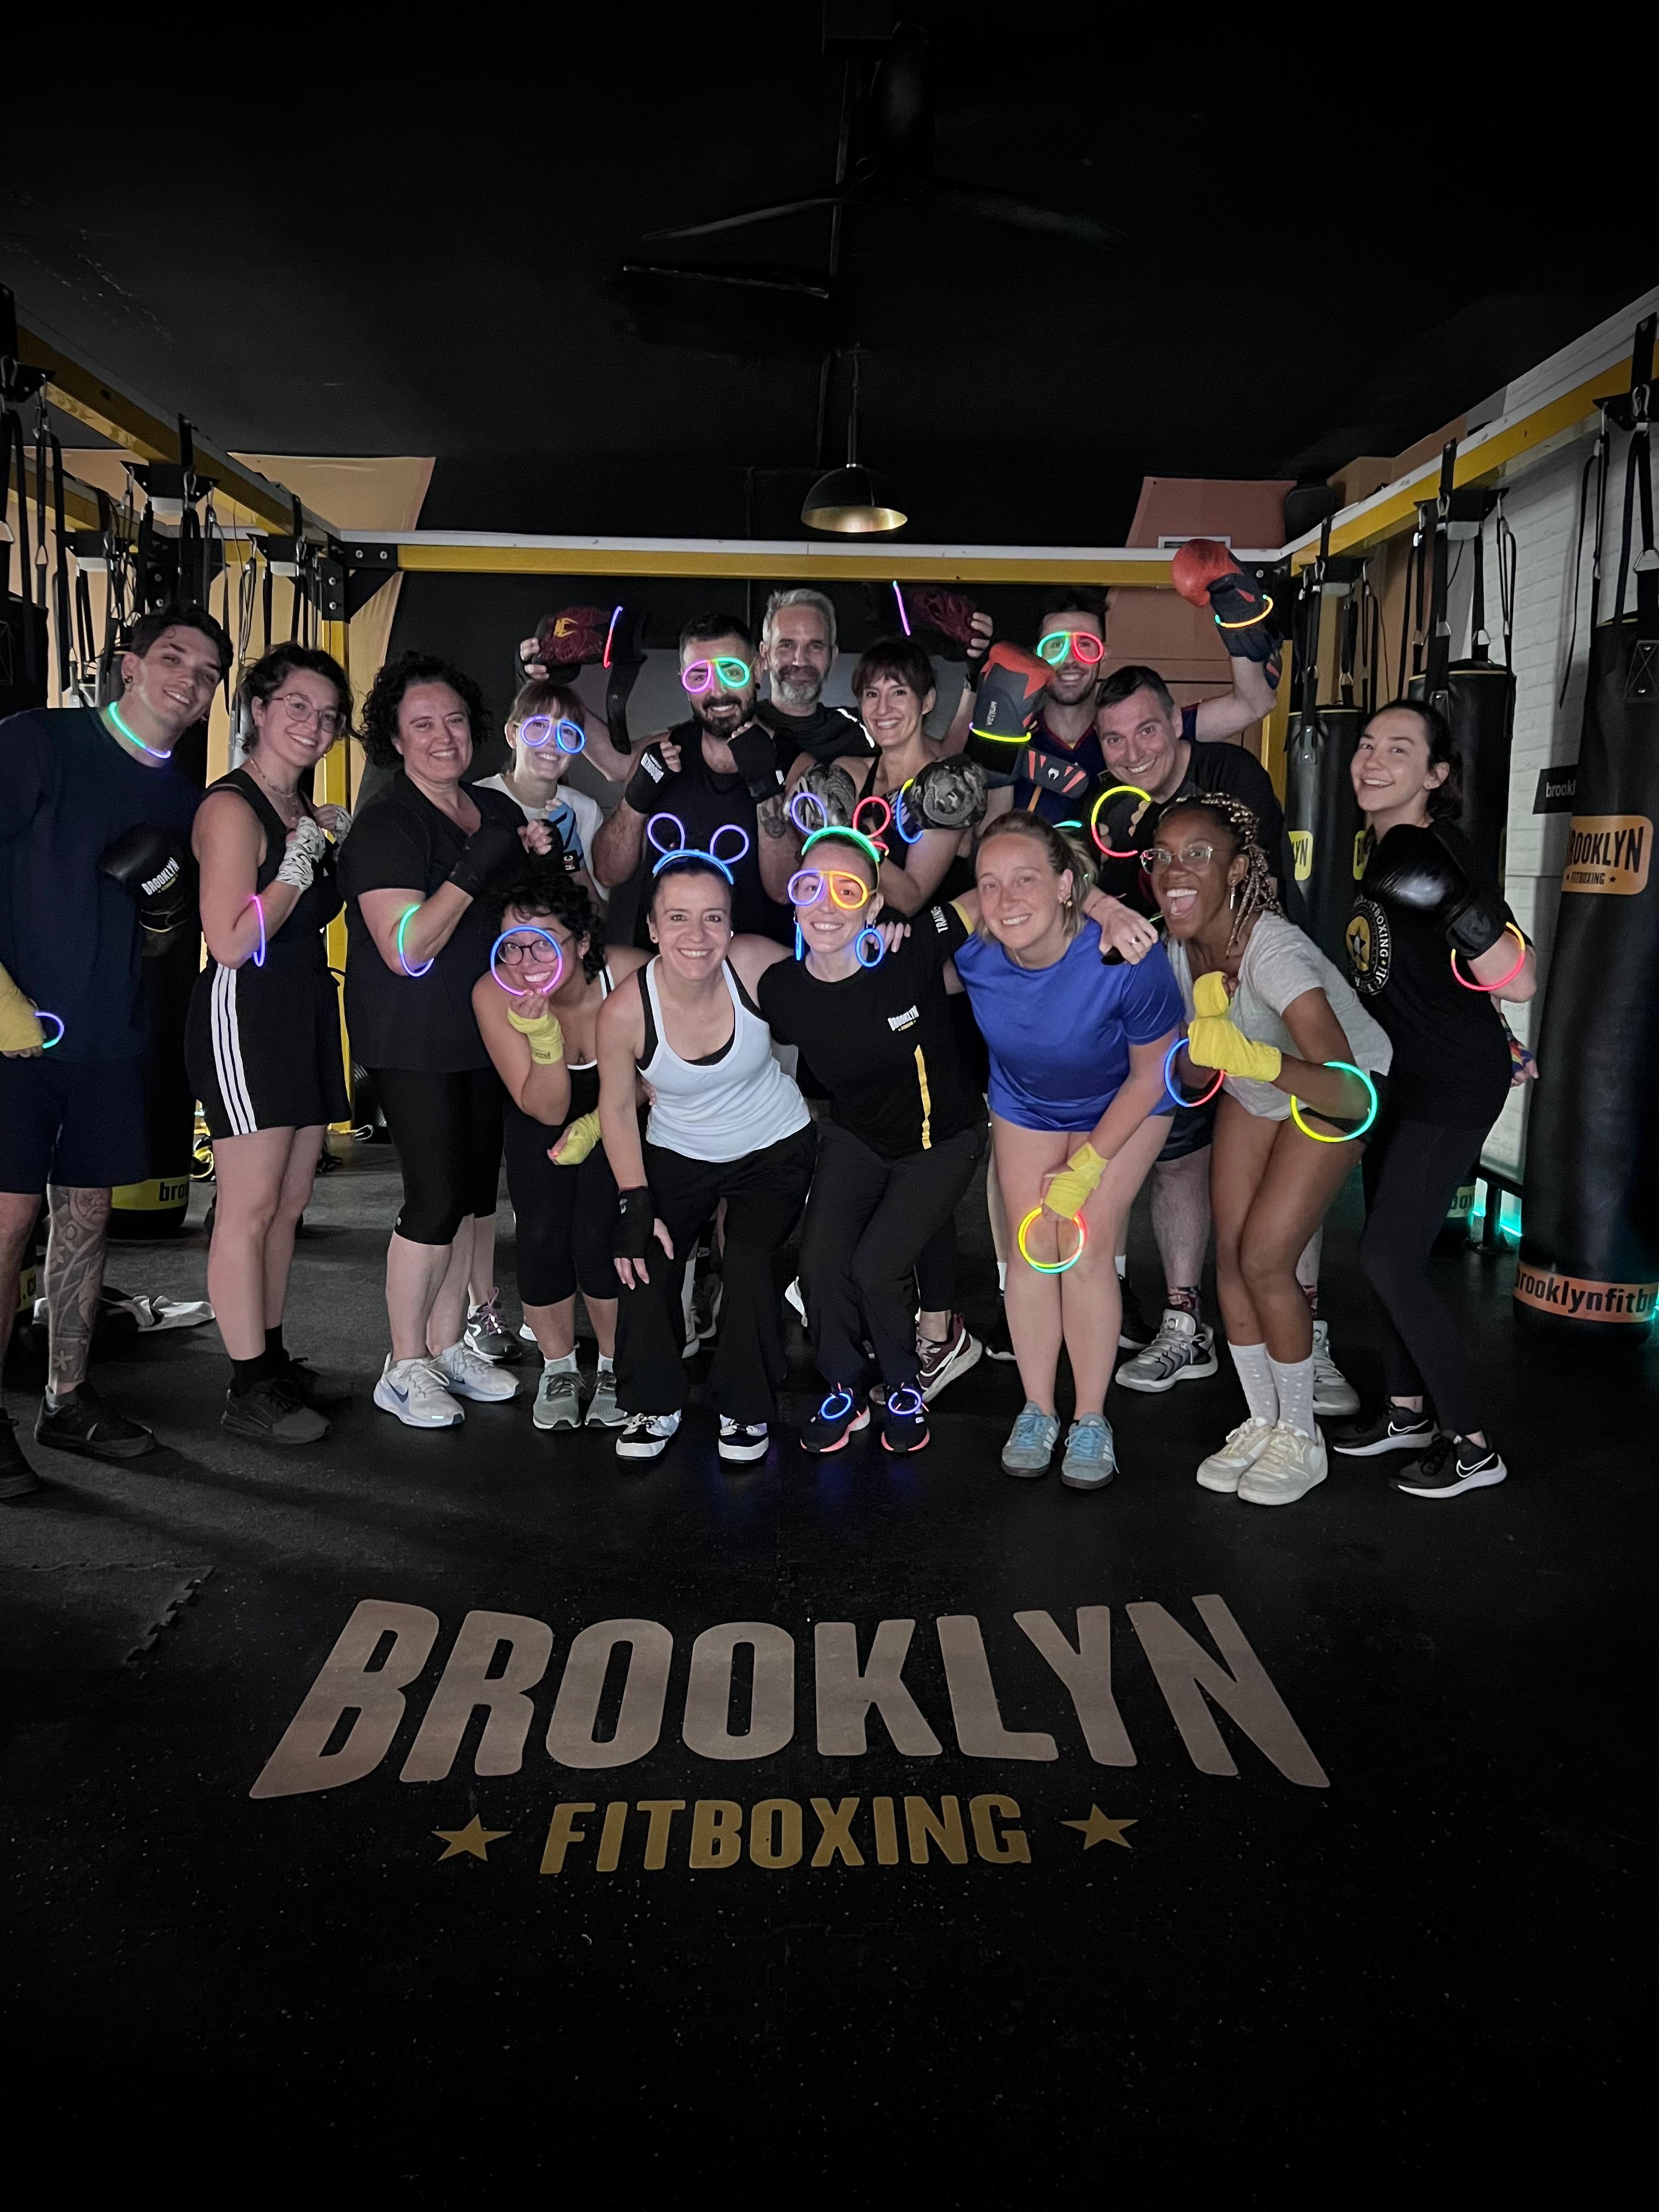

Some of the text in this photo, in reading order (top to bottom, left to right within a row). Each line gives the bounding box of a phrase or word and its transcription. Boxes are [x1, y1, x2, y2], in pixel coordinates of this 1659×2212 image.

[141, 857, 180, 895] BROOKLYN
[249, 1594, 1331, 1799] BROOKLYN
[540, 1794, 1032, 1874] FITBOXING
